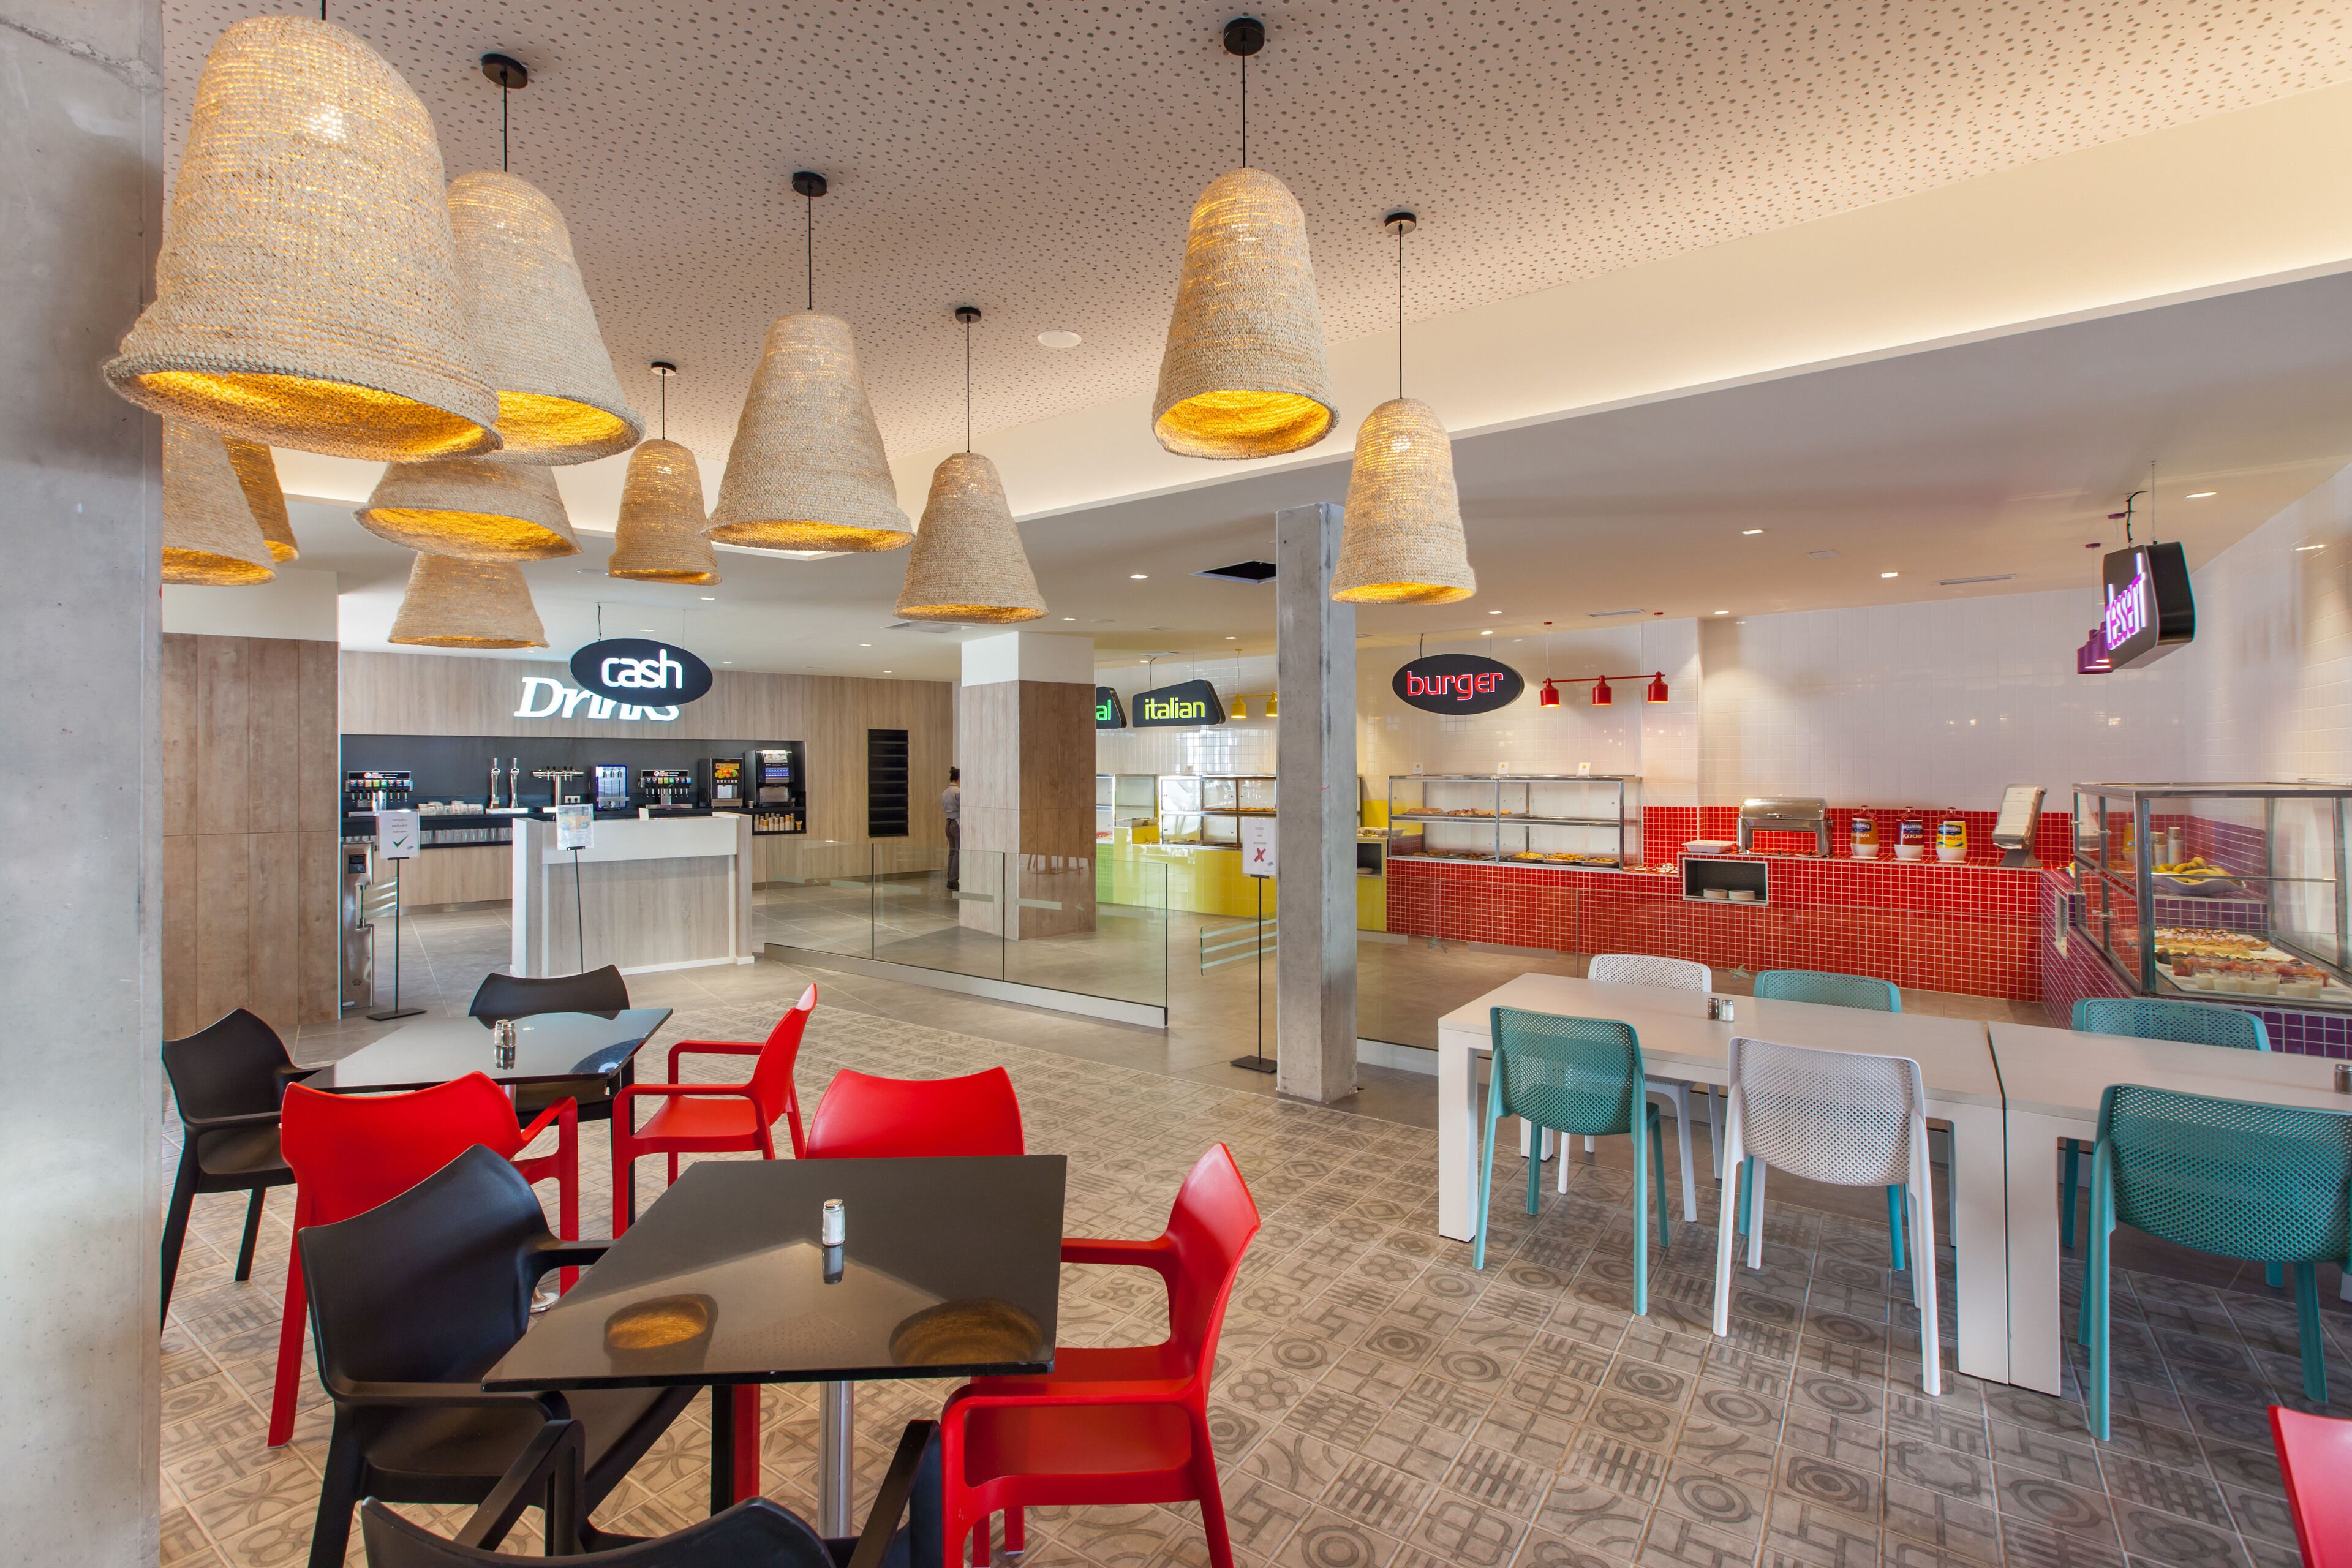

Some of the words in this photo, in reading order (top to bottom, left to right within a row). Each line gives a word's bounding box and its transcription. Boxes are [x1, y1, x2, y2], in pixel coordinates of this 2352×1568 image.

[2106, 552, 2146, 650] dessert
[601, 649, 683, 689] cash
[1407, 670, 1504, 701] burger
[1145, 697, 1205, 720] italian
